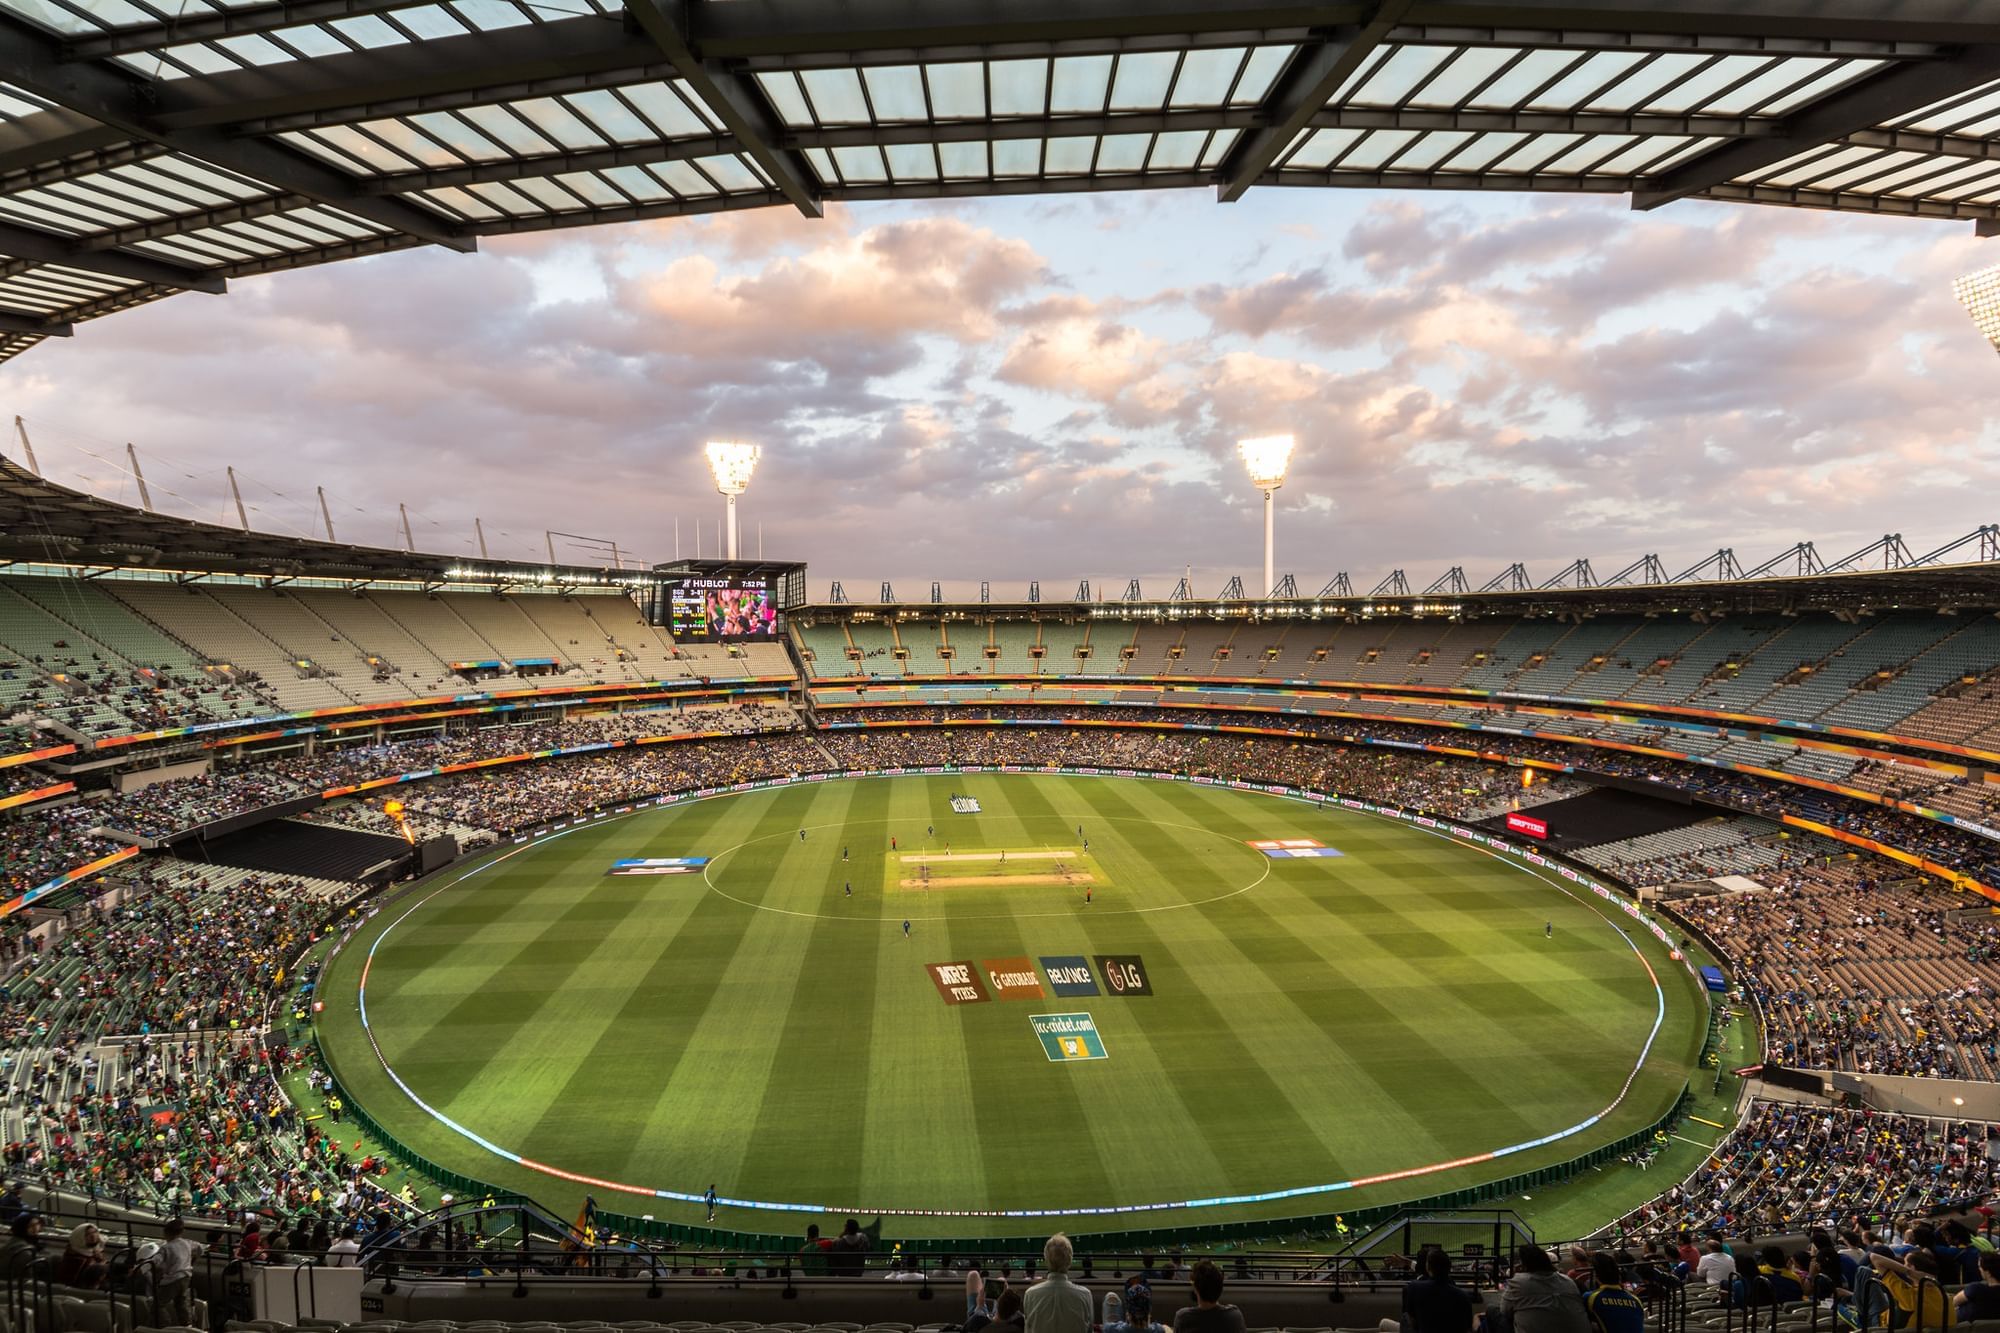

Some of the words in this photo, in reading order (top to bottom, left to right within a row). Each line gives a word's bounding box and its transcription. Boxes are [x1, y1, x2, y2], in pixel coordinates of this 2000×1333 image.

[692, 580, 729, 588] HUBLOT
[936, 964, 970, 985] MRF
[1000, 972, 1040, 986] GATORADE
[1122, 964, 1142, 988] LG
[951, 986, 978, 1000] TYRES
[1033, 1016, 1094, 1034] icc-cricket.com
